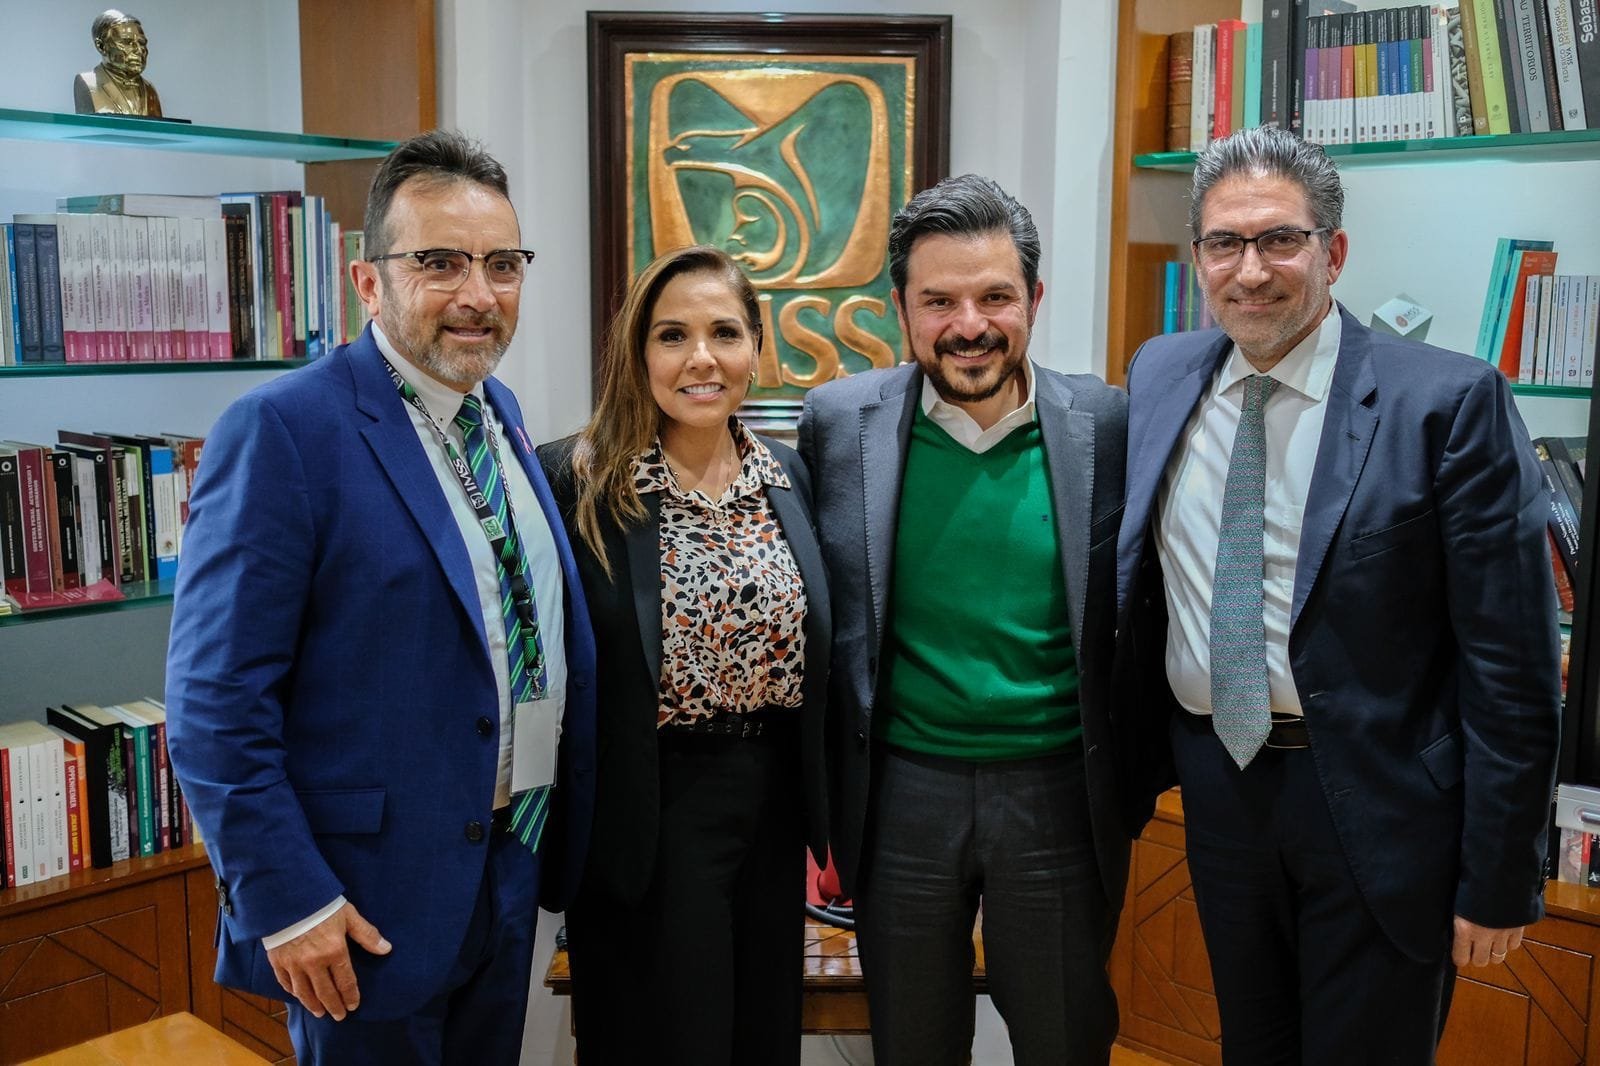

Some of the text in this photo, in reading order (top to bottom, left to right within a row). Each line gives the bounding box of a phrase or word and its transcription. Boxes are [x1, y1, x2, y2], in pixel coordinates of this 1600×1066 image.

[1522, 15, 1537, 81] TERRITORIOS
[453, 458, 477, 492] IMSS
[68, 765, 76, 808] OPPENHEIMER
